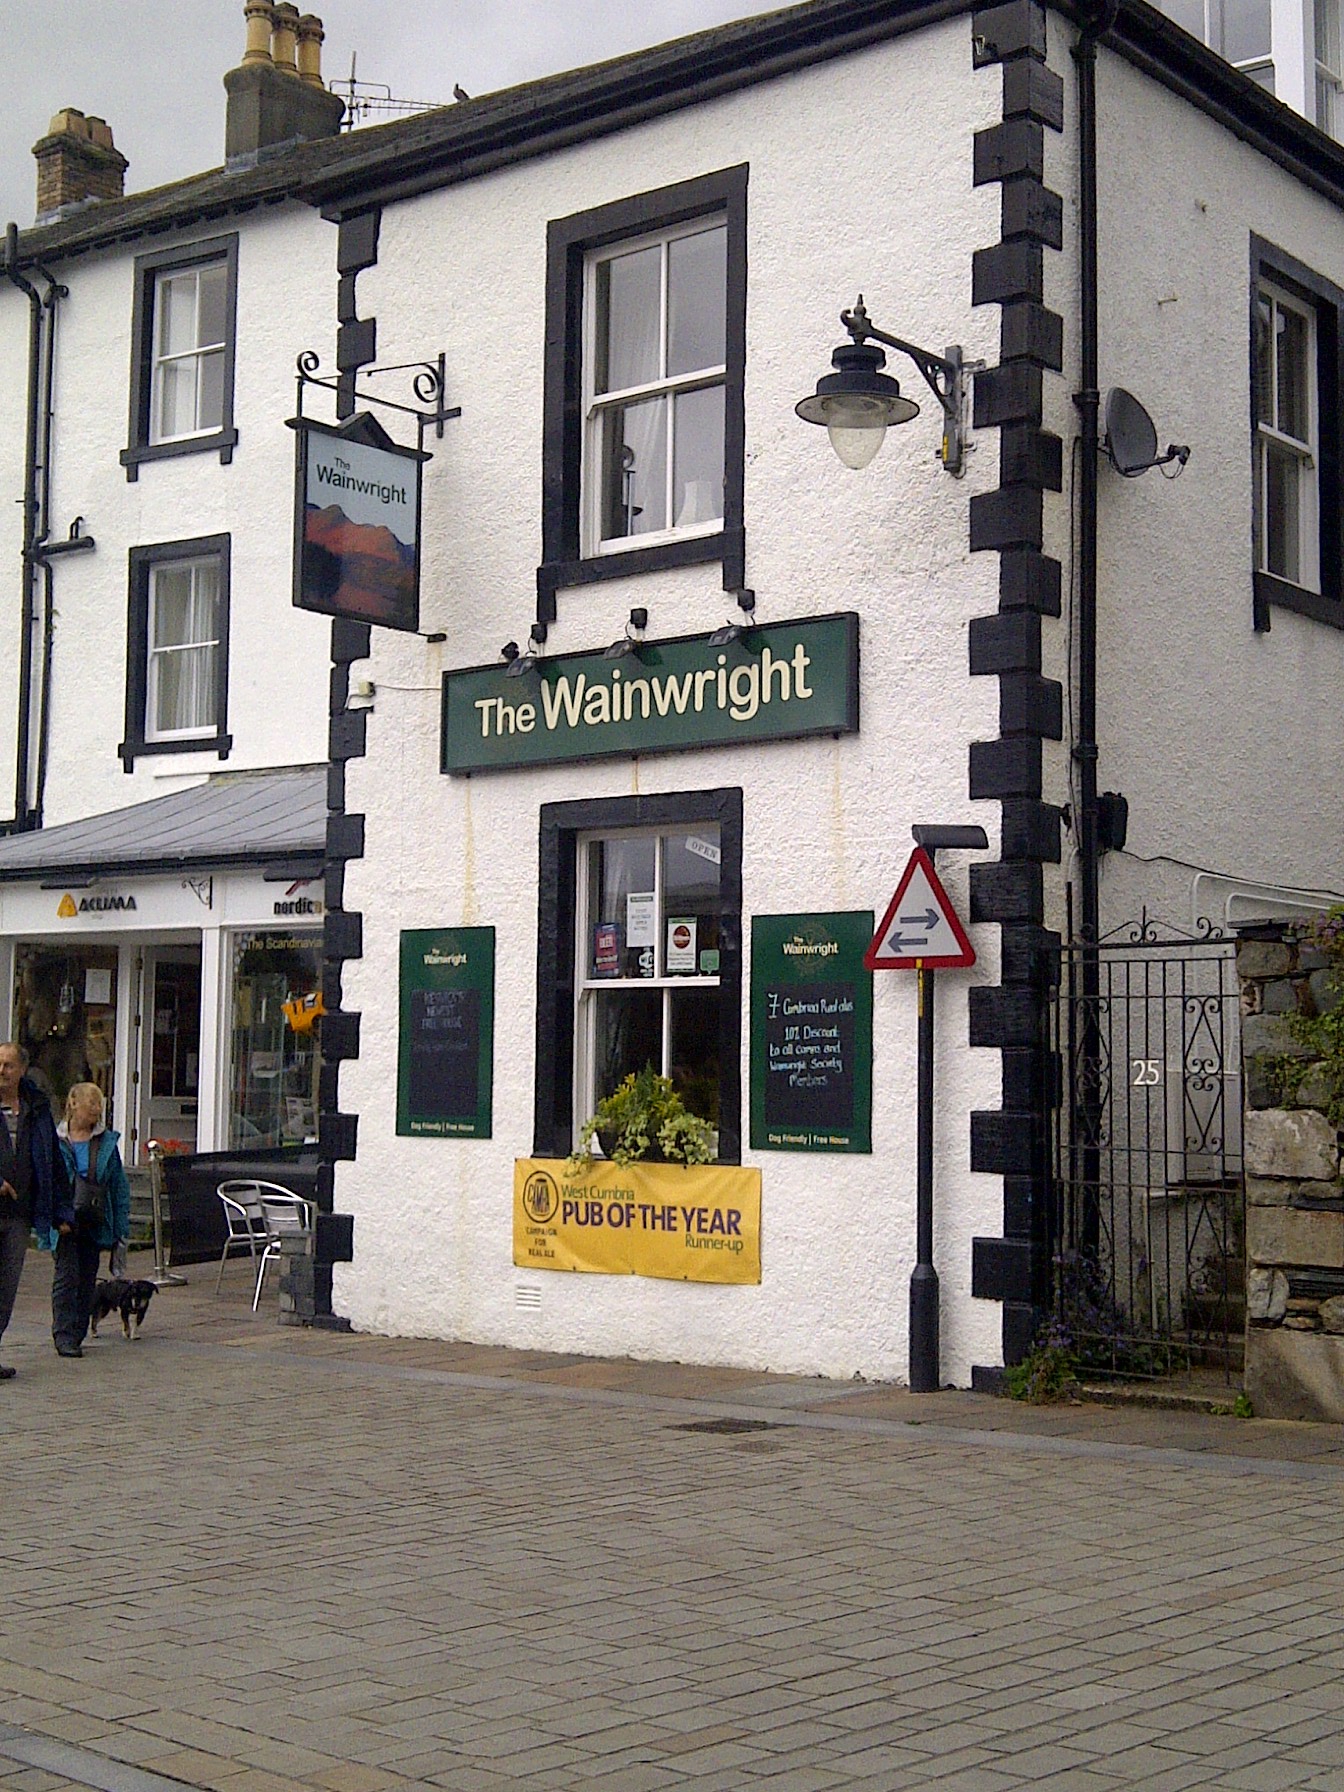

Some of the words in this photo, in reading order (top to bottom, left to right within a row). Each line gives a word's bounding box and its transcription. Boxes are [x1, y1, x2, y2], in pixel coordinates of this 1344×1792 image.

[335, 456, 350, 470] The
[316, 464, 407, 504] Wainwright
[475, 697, 536, 738] The
[540, 643, 813, 731] Wainwright
[692, 841, 718, 858] OPEN
[266, 937, 325, 950] Scandinavia
[782, 941, 839, 956] Wainwright
[769, 1042, 780, 1057] to
[782, 1043, 794, 1055] all
[823, 1040, 841, 1054] and
[1133, 1060, 1159, 1085] 25
[768, 1133, 781, 1145] Dog
[782, 1134, 808, 1145] Friendly
[813, 1134, 828, 1144] Free
[829, 1136, 850, 1145] House
[561, 1185, 588, 1199] West
[589, 1185, 635, 1200] Cumbria
[562, 1201, 604, 1227] PUB
[607, 1202, 636, 1229] OF
[637, 1203, 677, 1232] THE
[681, 1206, 742, 1236] YEAR
[526, 1226, 558, 1236] CAMPAIGN
[534, 1238, 546, 1247] FOR
[685, 1234, 744, 1255] Runner-up
